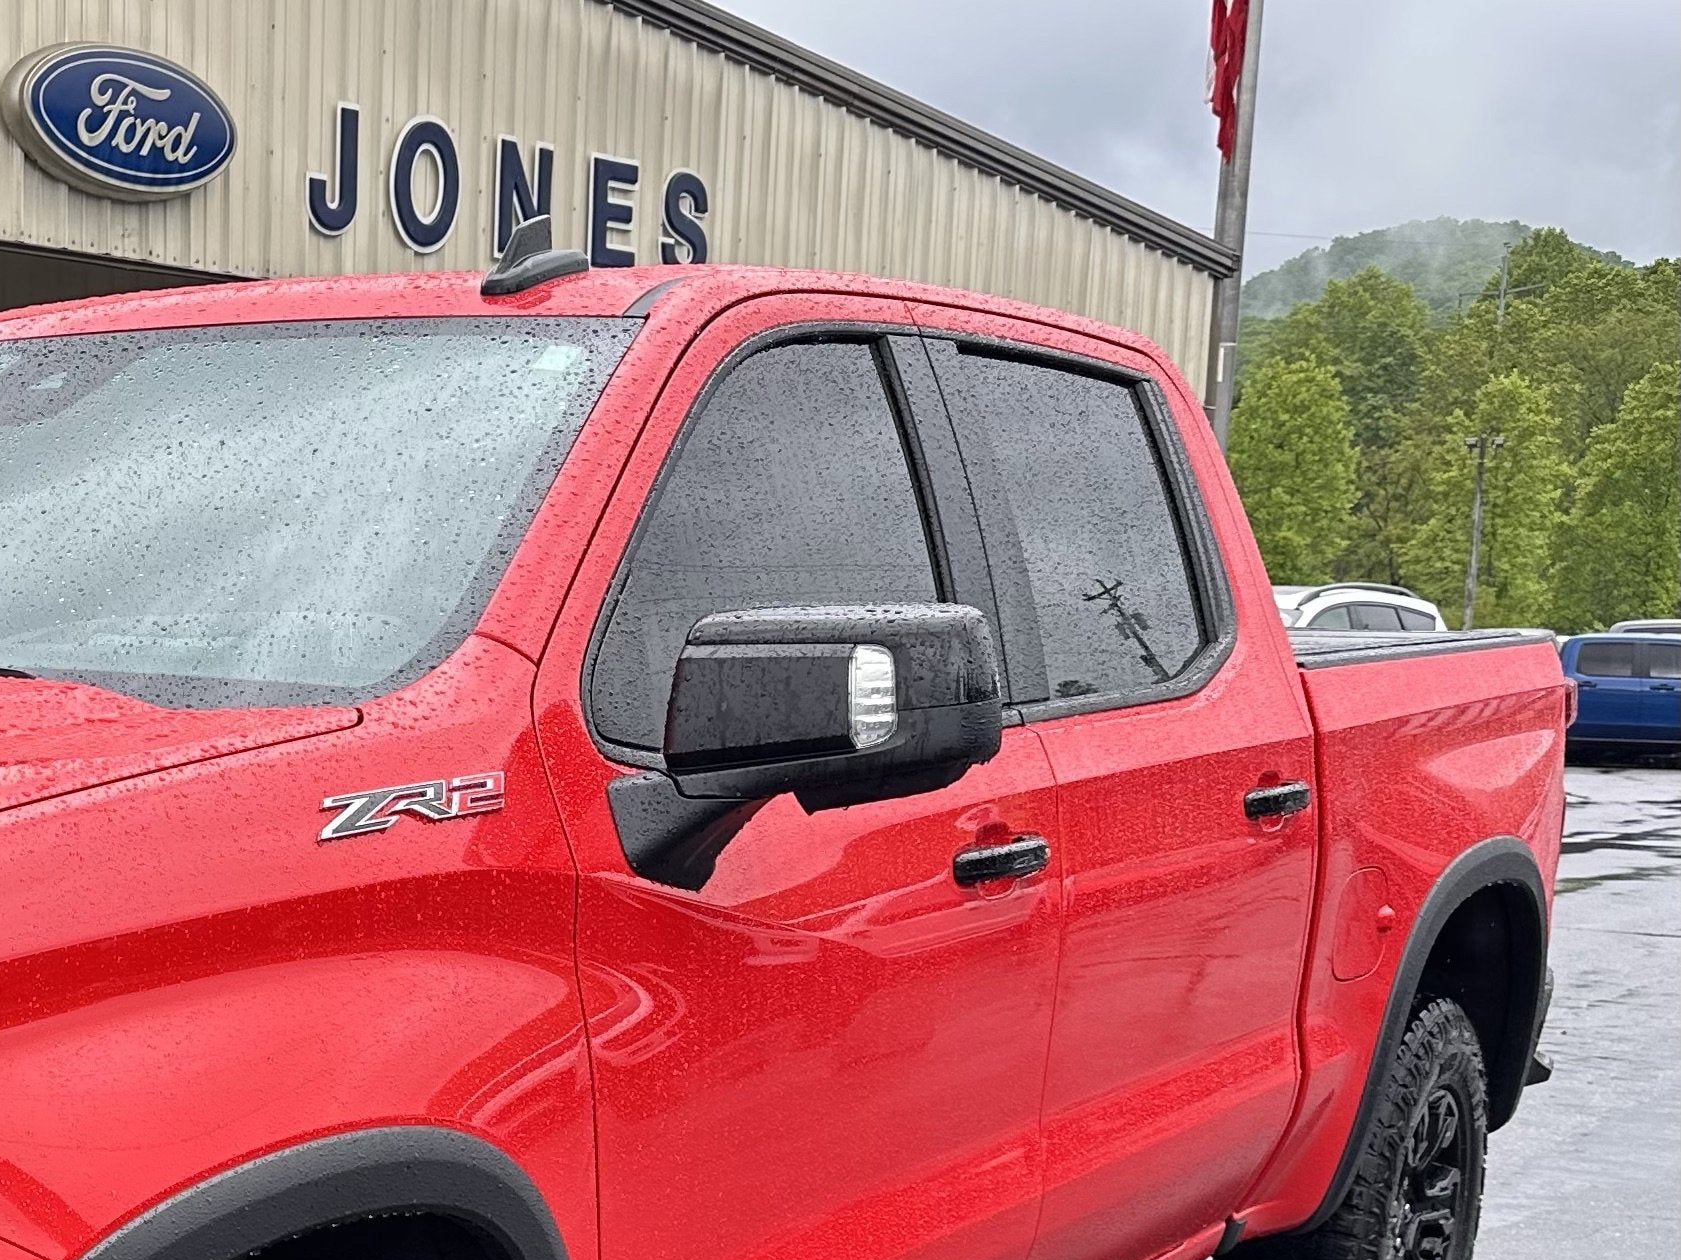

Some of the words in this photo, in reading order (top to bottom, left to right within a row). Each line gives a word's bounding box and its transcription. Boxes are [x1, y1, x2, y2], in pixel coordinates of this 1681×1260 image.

[77, 73, 201, 165] Ford
[306, 102, 708, 267] JONES
[318, 771, 504, 840] ZR2
